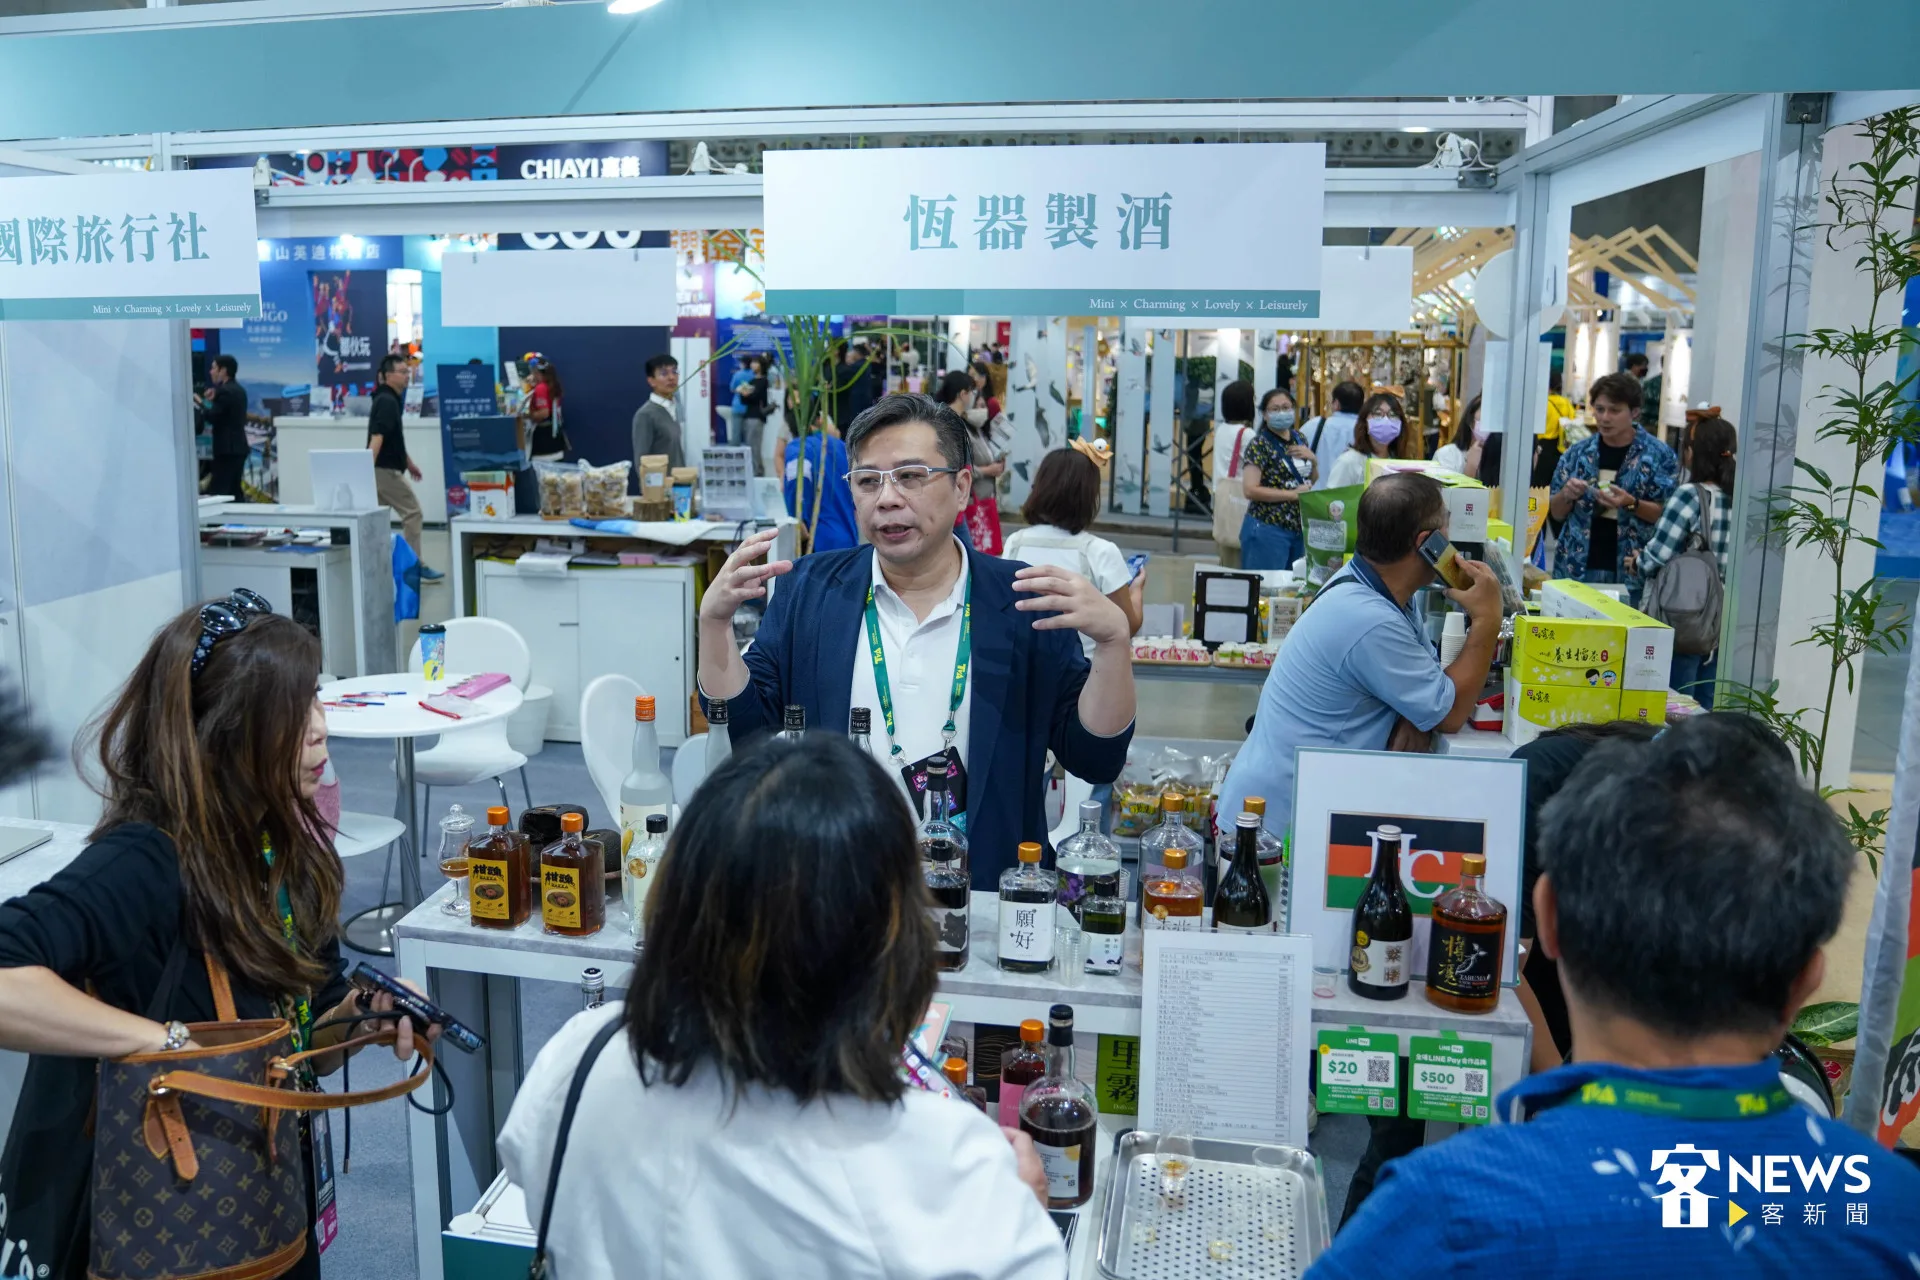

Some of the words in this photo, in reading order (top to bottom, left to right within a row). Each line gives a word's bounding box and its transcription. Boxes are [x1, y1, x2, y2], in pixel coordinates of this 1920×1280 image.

[520, 158, 598, 180] CHIAYI
[903, 191, 1173, 251] 恆器製酒
[0, 211, 210, 266] 國際旅行社
[93, 304, 111, 314] Mini
[124, 304, 162, 315] Charming
[175, 303, 201, 315] Lovely
[215, 302, 251, 313] Leisurely
[1089, 298, 1114, 309] Mini
[1133, 298, 1186, 312] Charming
[1204, 299, 1240, 312] Lovely
[1259, 299, 1308, 312] Leisurely
[1010, 908, 1037, 950] 願好
[1328, 1060, 1358, 1075] $20
[1420, 1071, 1455, 1085] $500
